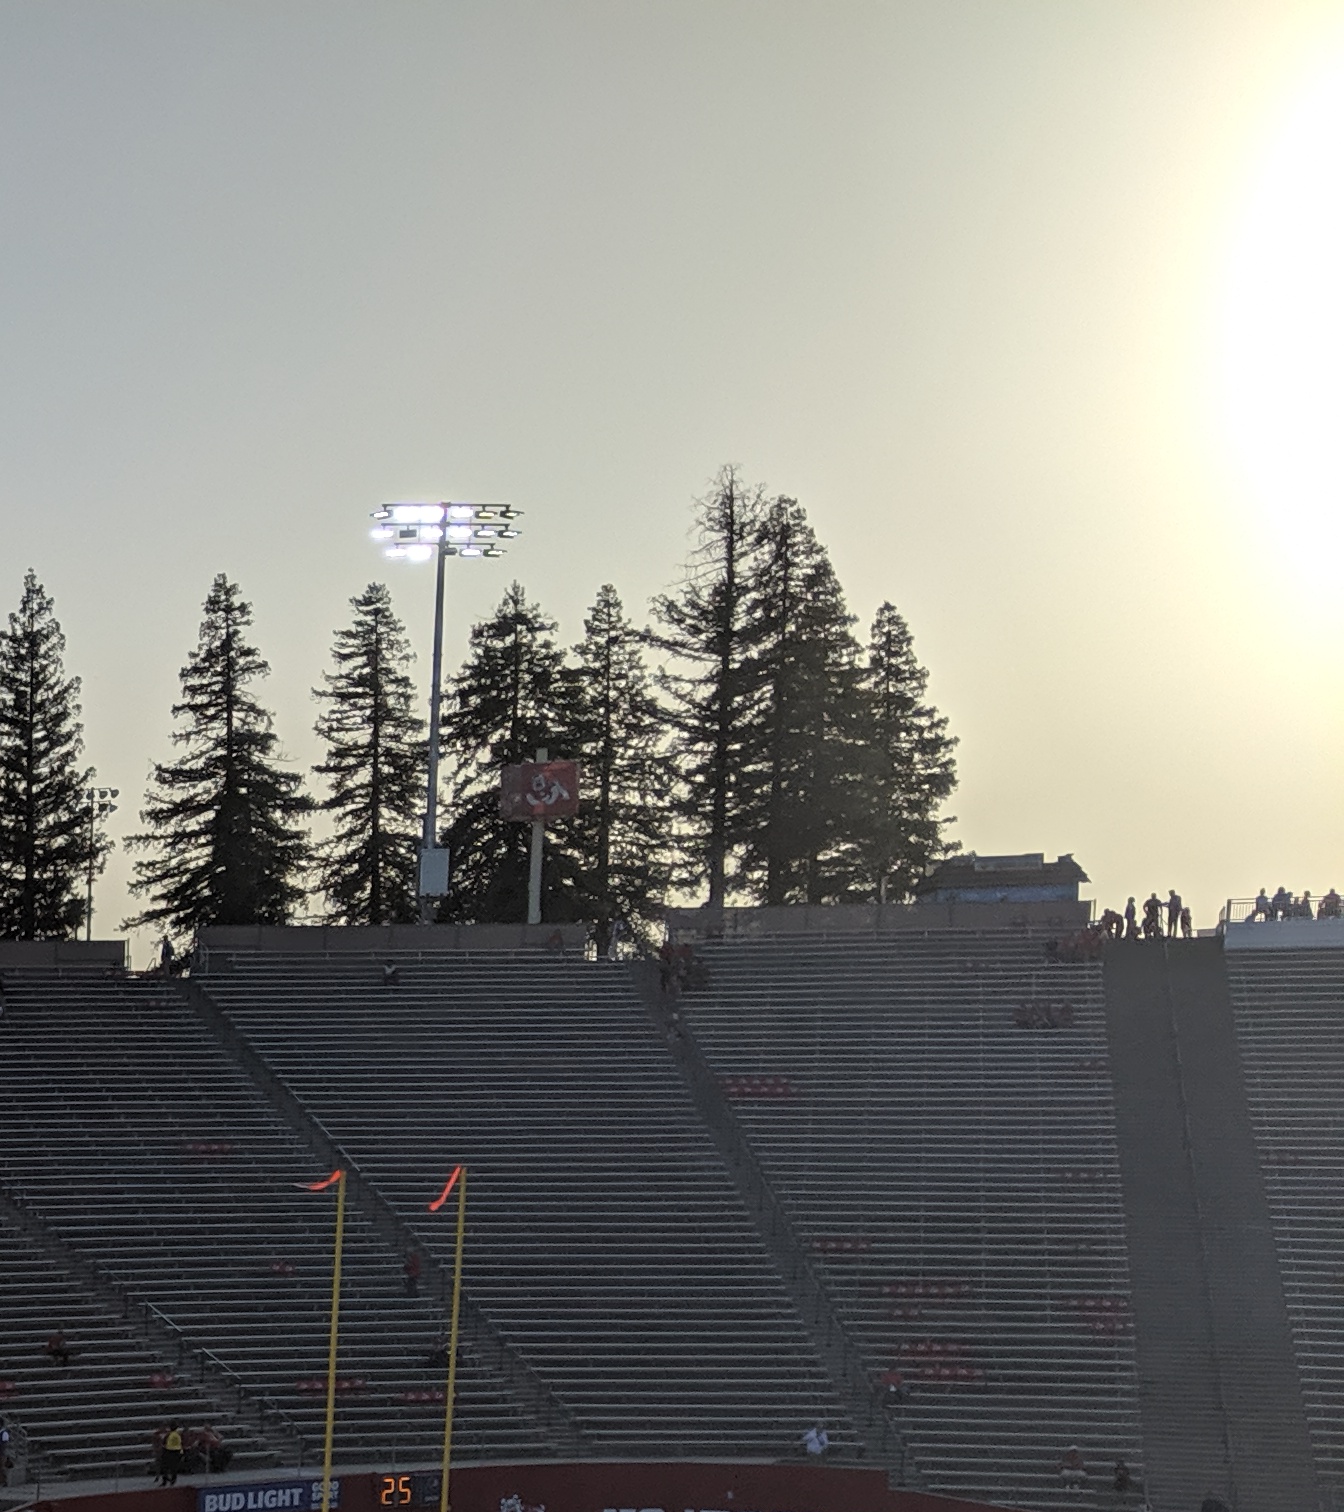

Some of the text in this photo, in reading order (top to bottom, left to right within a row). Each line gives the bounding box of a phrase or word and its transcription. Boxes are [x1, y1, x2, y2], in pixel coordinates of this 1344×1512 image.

[204, 1488, 303, 1512] BUD LIGHT
[380, 1476, 412, 1506] 25
